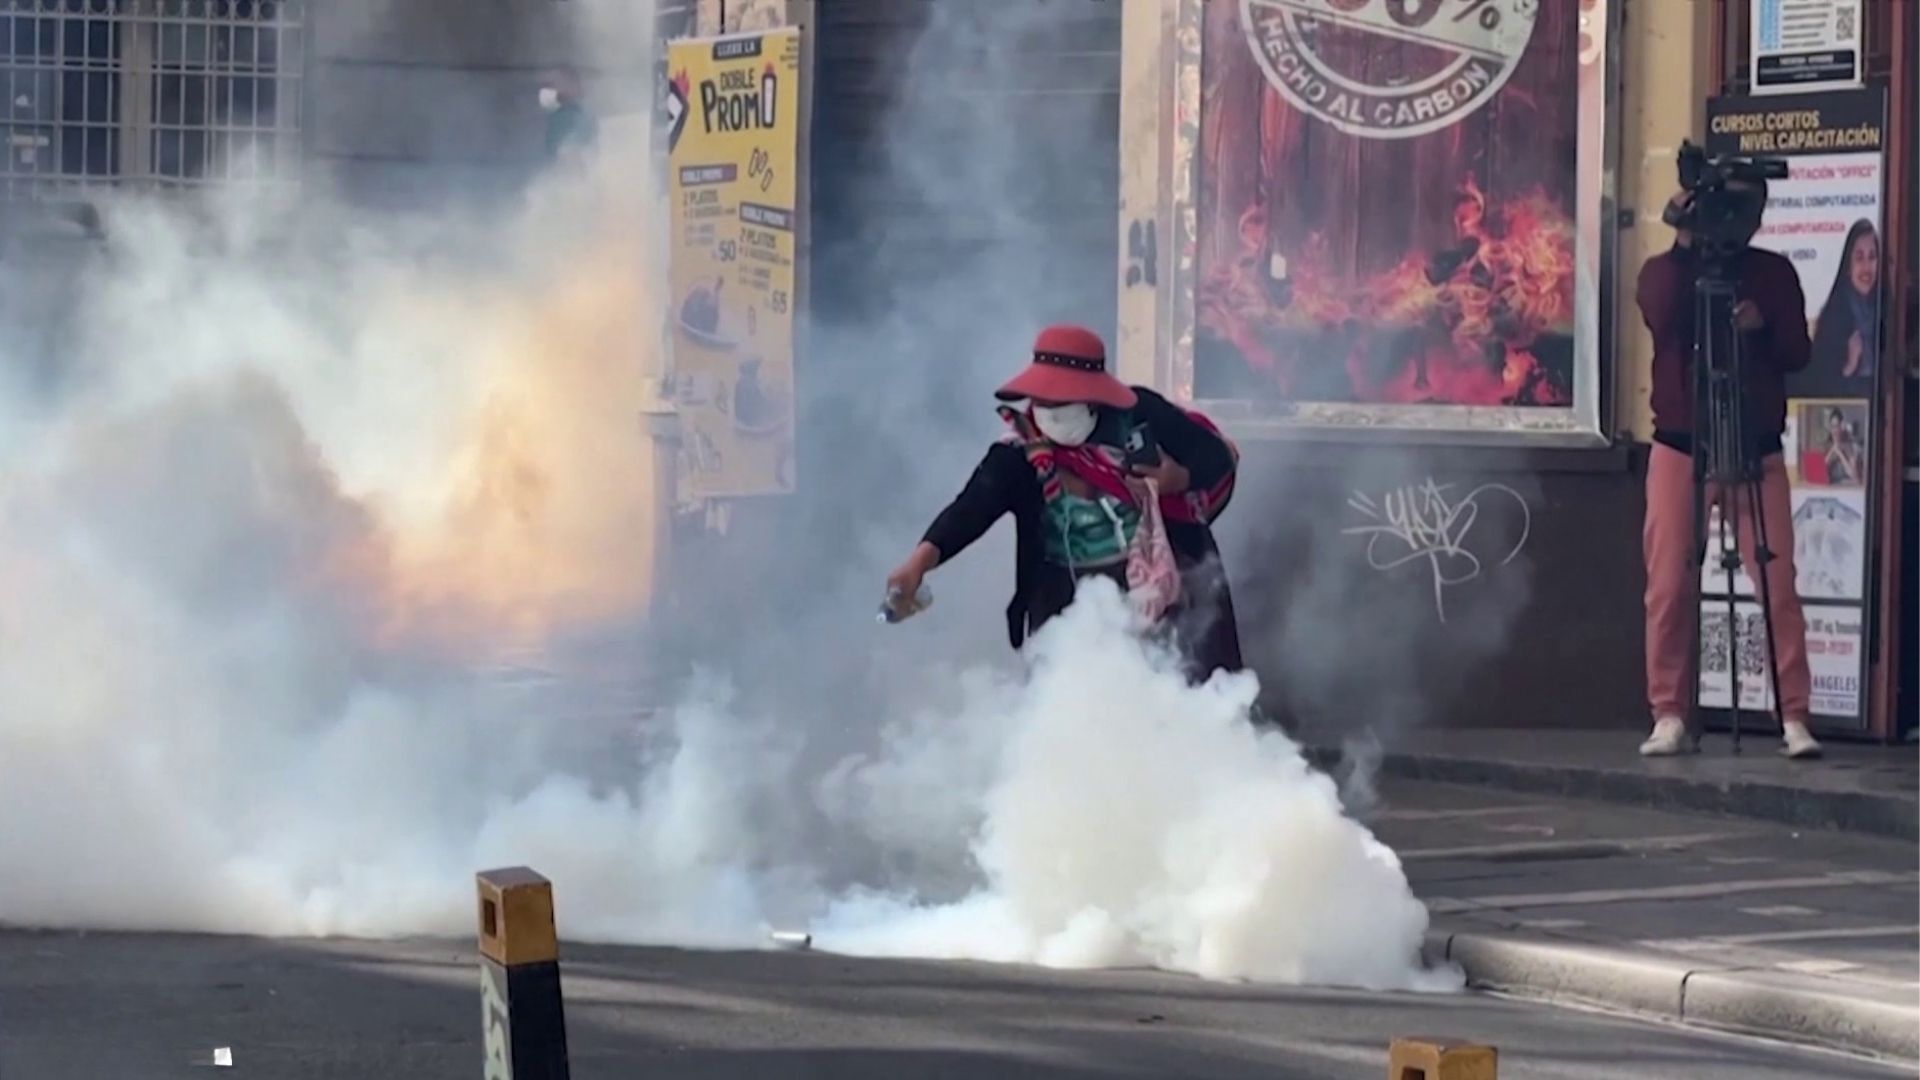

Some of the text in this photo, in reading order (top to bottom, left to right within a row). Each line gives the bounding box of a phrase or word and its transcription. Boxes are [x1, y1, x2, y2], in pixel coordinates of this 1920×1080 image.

[719, 68, 756, 91] DOBLE
[1258, 17, 1491, 125] HECHO AL CARBON
[700, 72, 777, 134] PROMO
[1711, 110, 1820, 134] CURSOS CORTOS
[1740, 122, 1880, 151] NIVEL CAPACITACIÓN
[1813, 674, 1857, 692] ANGELES
